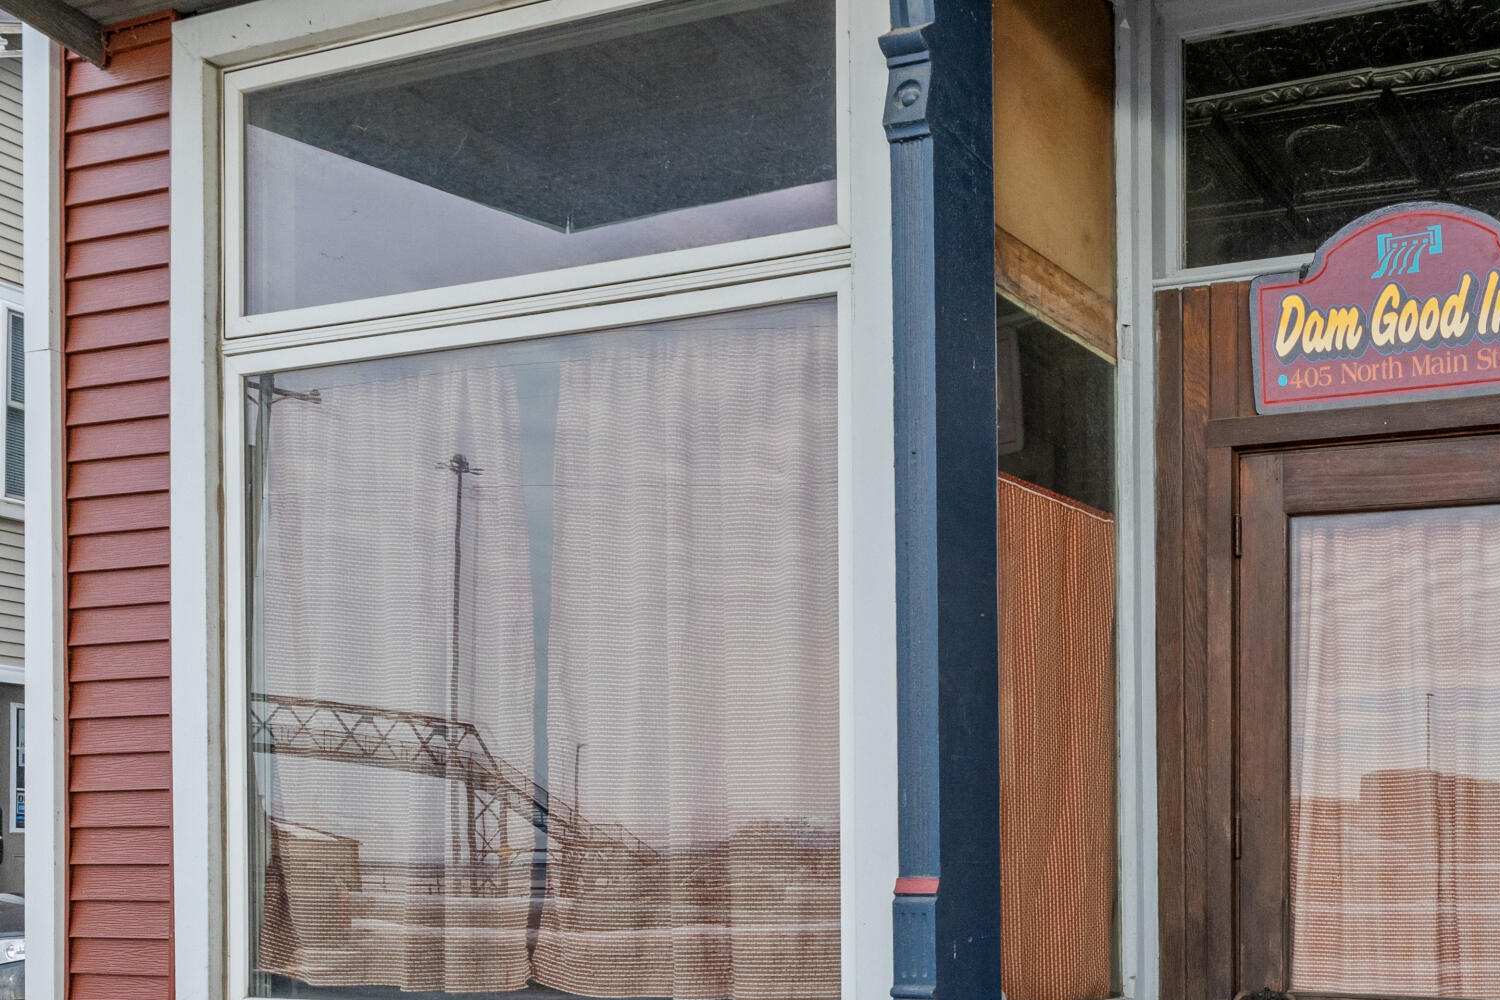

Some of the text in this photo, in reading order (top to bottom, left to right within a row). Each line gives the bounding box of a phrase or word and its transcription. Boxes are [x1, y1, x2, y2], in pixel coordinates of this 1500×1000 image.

[1275, 294, 1362, 357] Dam
[1371, 273, 1470, 346] Good
[1290, 366, 1332, 389] 405
[1340, 355, 1402, 385] North
[1411, 351, 1468, 376] Main
